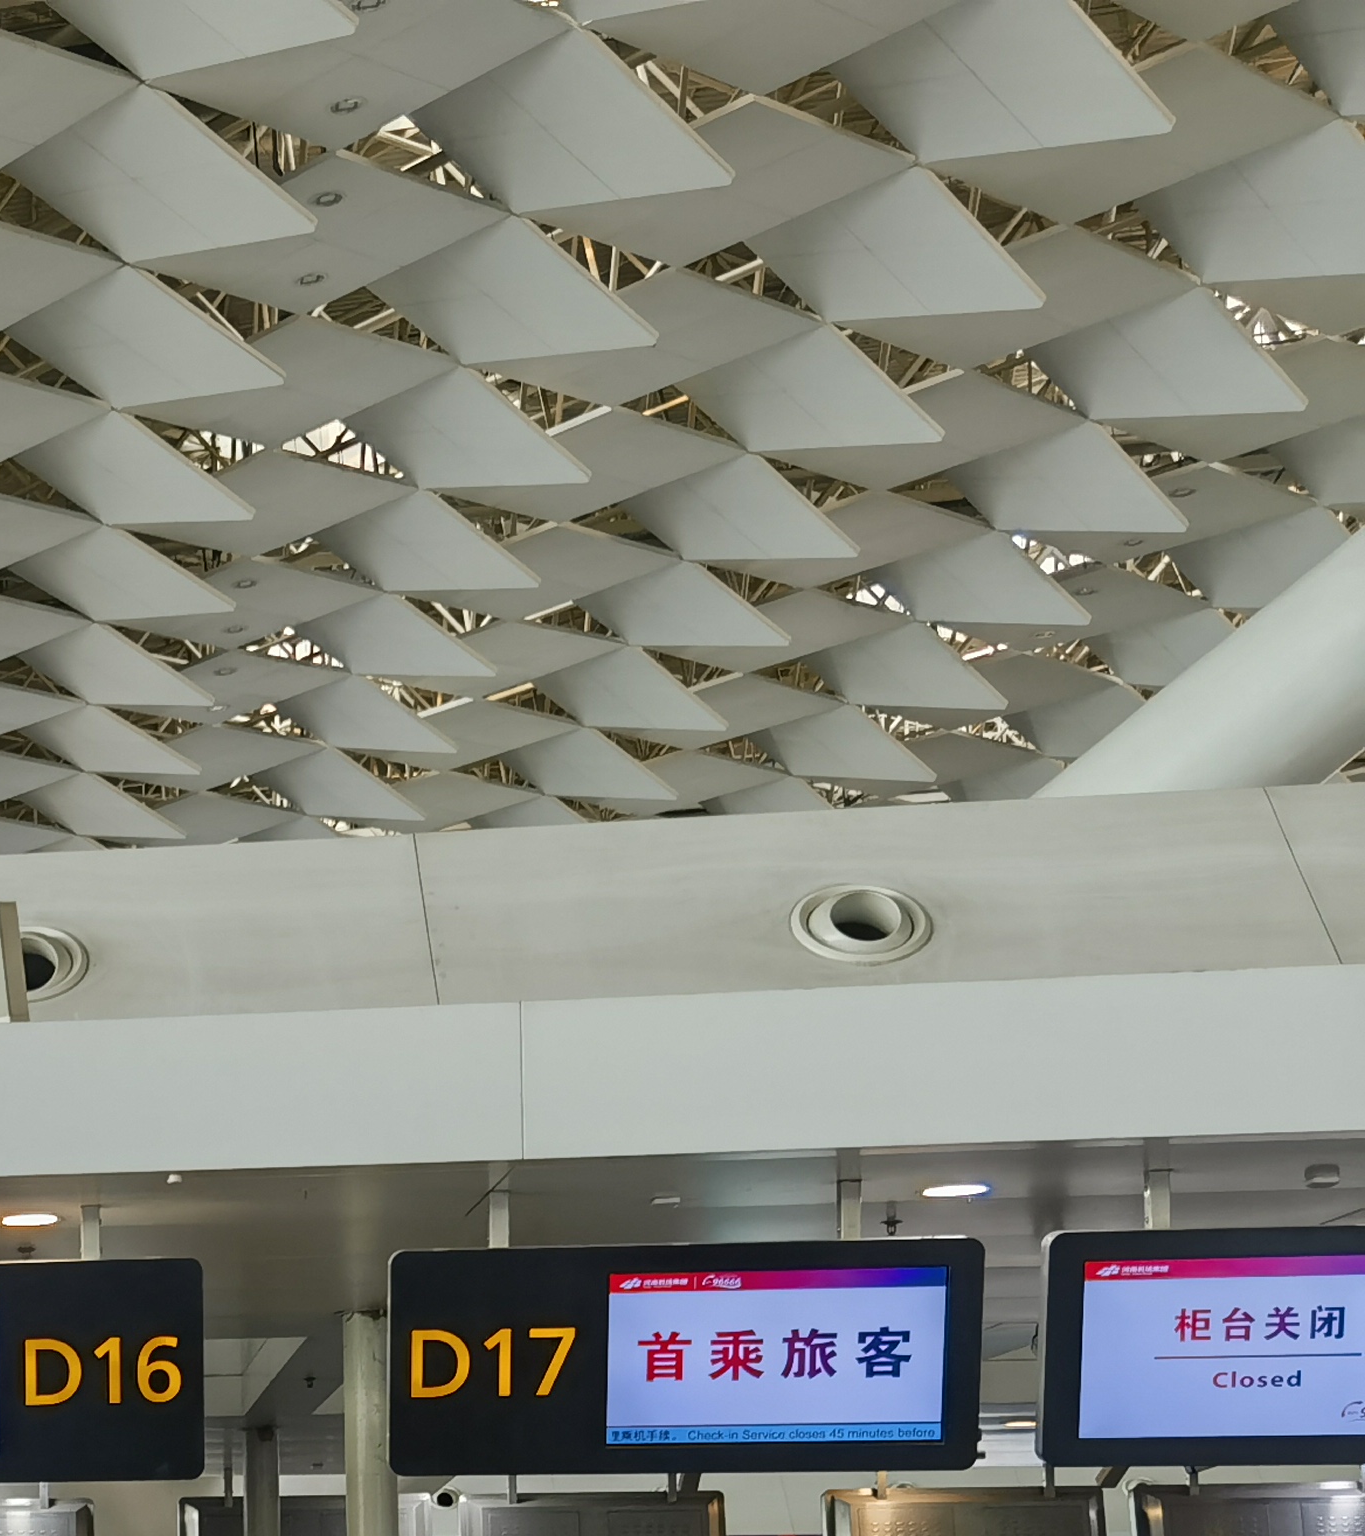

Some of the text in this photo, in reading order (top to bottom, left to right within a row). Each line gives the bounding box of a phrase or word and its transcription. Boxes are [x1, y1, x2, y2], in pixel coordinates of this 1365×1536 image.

[1174, 1305, 1346, 1342] 柜台关闭
[23, 1335, 182, 1406] D16
[410, 1327, 576, 1399] D17
[637, 1327, 913, 1383] 首乘旅客
[1212, 1370, 1302, 1388] Closed
[687, 1429, 739, 1440] Check-in
[742, 1429, 786, 1440] Service
[788, 1429, 826, 1440] closes
[829, 1428, 845, 1439] 45
[847, 1428, 894, 1438] minutes
[897, 1427, 936, 1438] before
